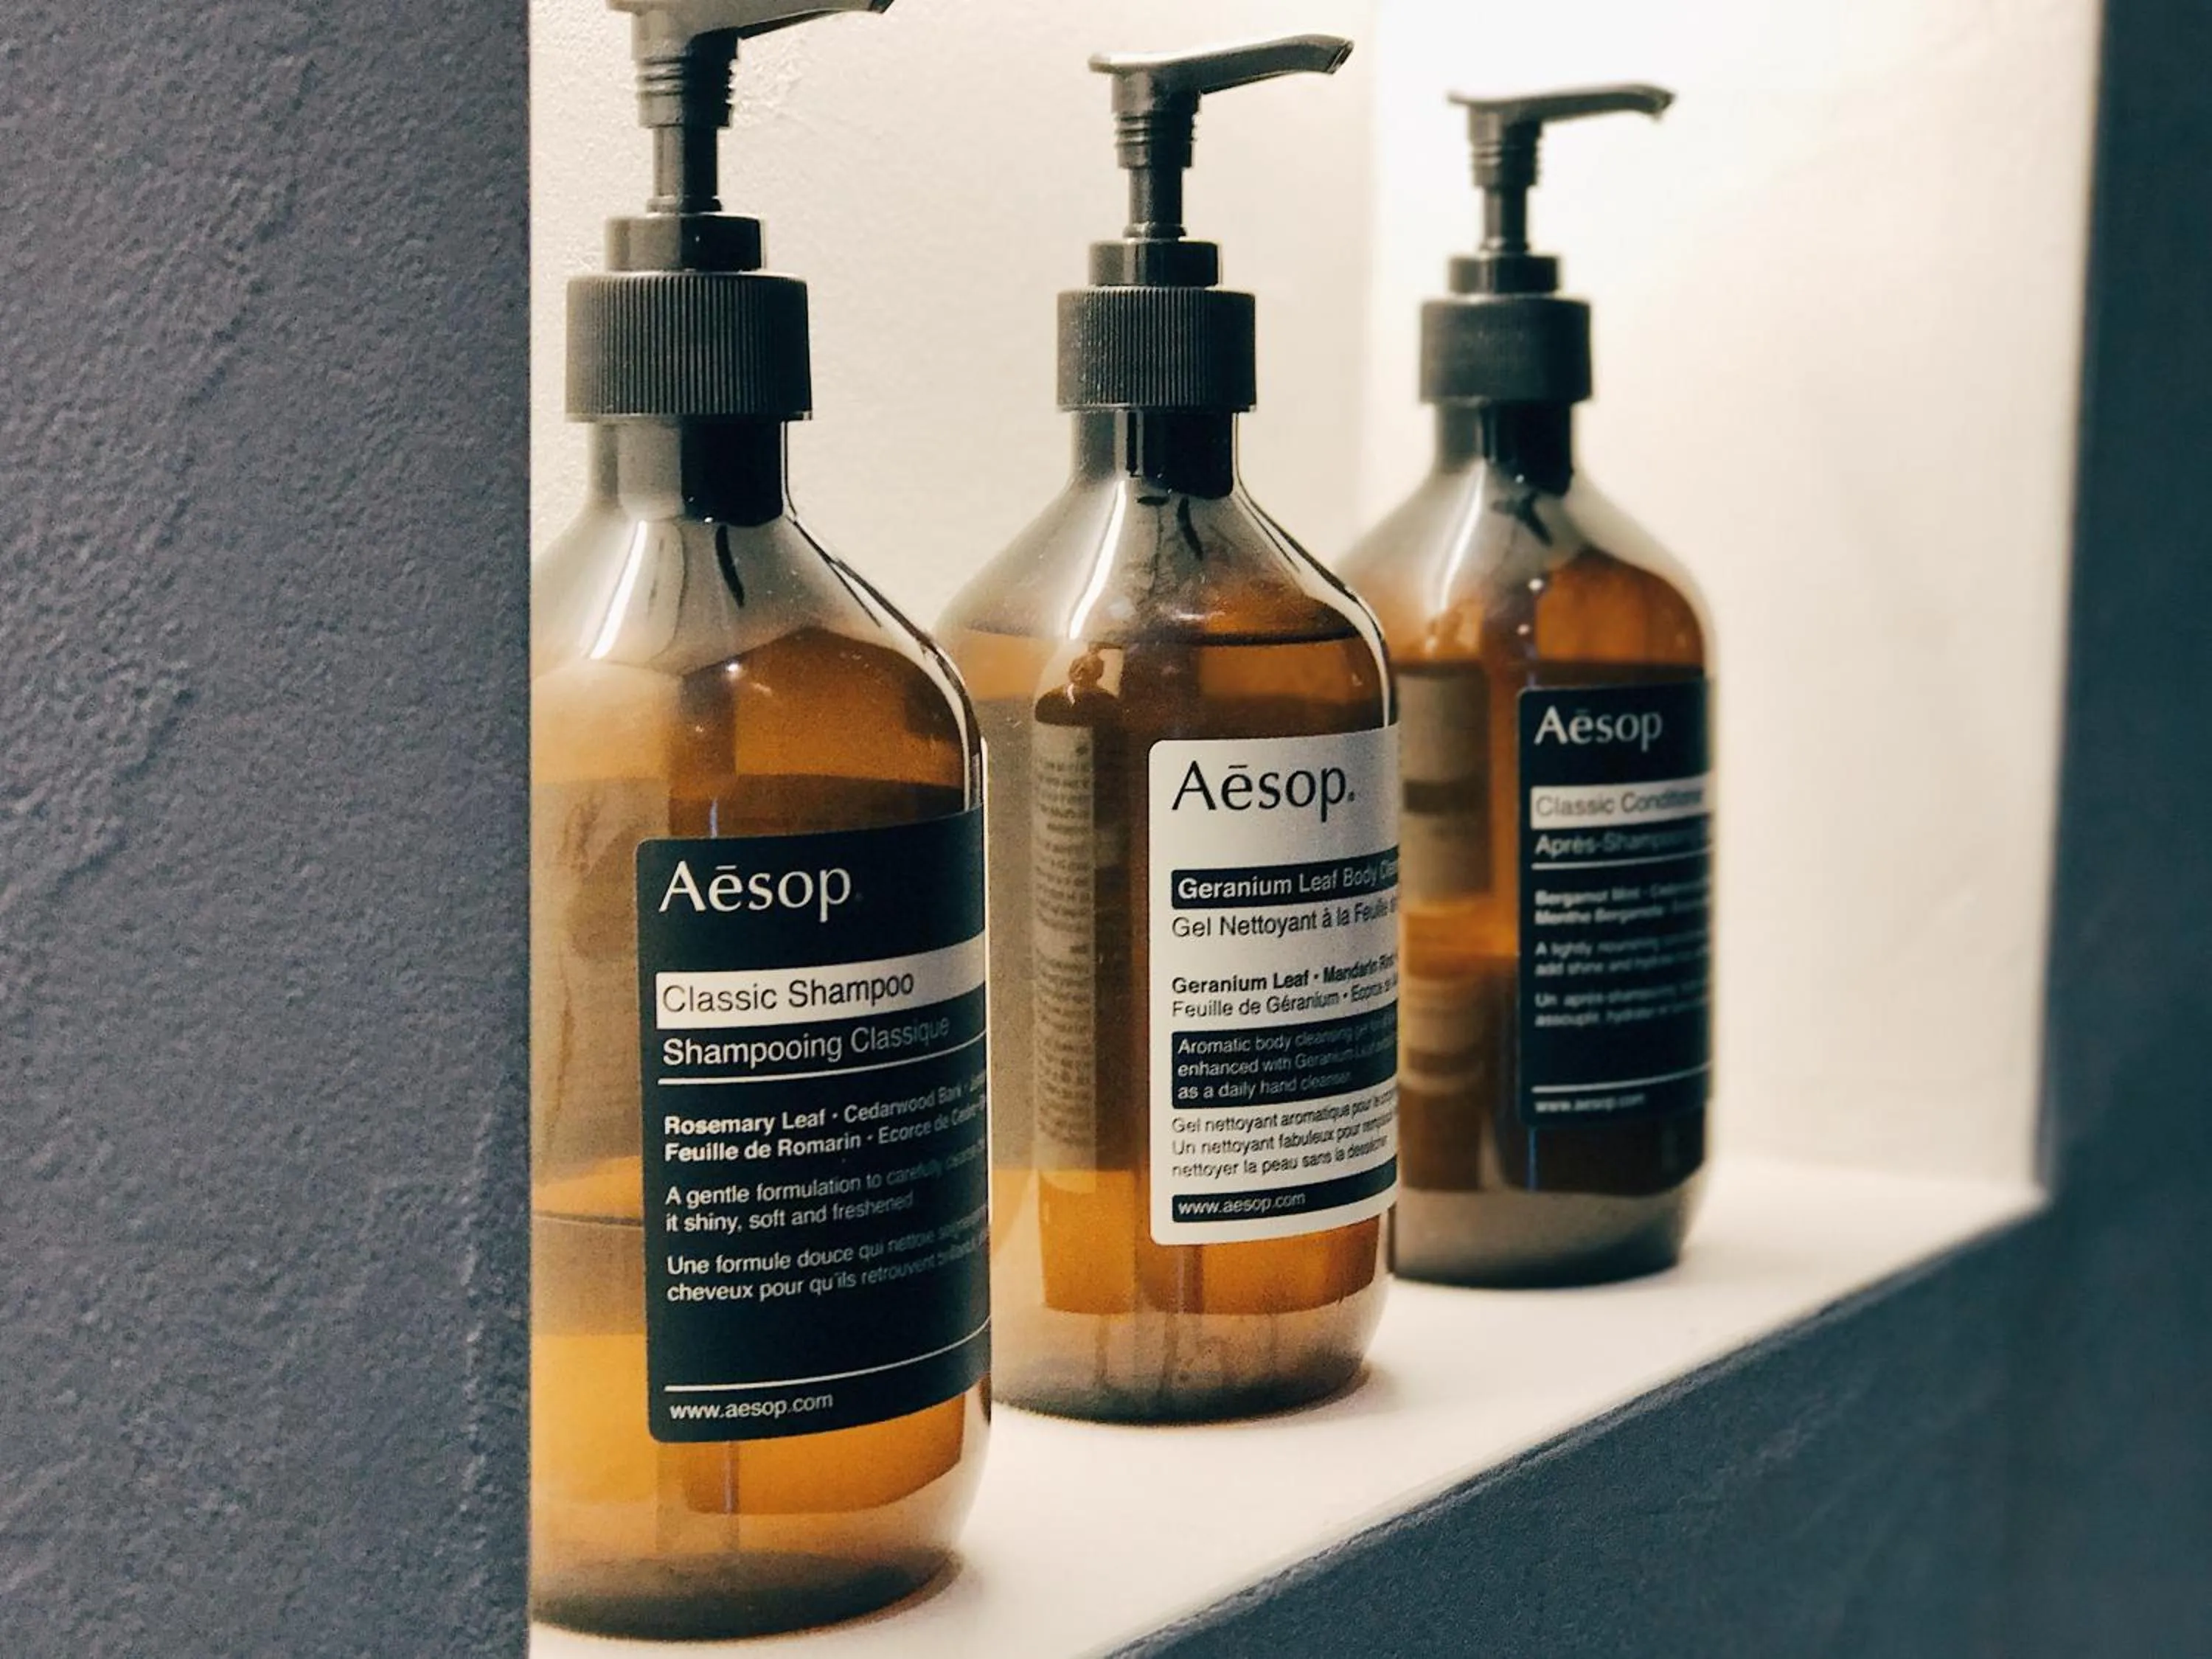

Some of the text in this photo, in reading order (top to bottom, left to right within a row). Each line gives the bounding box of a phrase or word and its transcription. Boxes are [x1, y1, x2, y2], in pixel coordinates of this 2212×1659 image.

[1535, 796, 1615, 817] Classic
[1178, 876, 1292, 899] Geranium
[1299, 870, 1338, 893] Leaf
[1343, 863, 1377, 887] Body
[1172, 917, 1211, 938] Gel
[1220, 911, 1318, 938] Nettoyant
[1337, 906, 1351, 926] la
[664, 973, 914, 1012] Classic Shampoo
[1172, 975, 1267, 993] Geranium
[1273, 970, 1310, 989] Leaf
[1172, 1000, 1233, 1018] Feuille
[1239, 998, 1262, 1015] de
[1266, 992, 1340, 1015] Géranium
[664, 1015, 950, 1068] Shampooing Classique
[1178, 1038, 1251, 1054] Aromatic
[1256, 1034, 1290, 1052] body
[1178, 1060, 1259, 1077] enhanced
[1262, 1057, 1291, 1072] with
[1178, 1086, 1198, 1099] as
[1203, 1087, 1214, 1099] a
[1218, 1080, 1256, 1099] daily
[1259, 1076, 1297, 1095] hand
[664, 1113, 776, 1136] Rosemary
[782, 1109, 826, 1130] Leaf
[844, 1091, 935, 1124] Cedarwood
[1172, 1117, 1200, 1134] Gel
[1205, 1113, 1278, 1133] nettoyant
[664, 1142, 738, 1162] Feuille
[745, 1138, 771, 1158] de
[778, 1132, 861, 1158] Romarin
[879, 1121, 931, 1144] Ecorce
[1172, 1124, 1361, 1159] Un nettoyant fabuleux pour
[1172, 1161, 1239, 1180] nettoyer
[1243, 1158, 1258, 1173] la
[1262, 1156, 1298, 1178] peau
[1301, 1150, 1333, 1168] sans
[665, 1188, 681, 1206] A
[686, 1186, 749, 1209] gentle
[757, 1174, 860, 1202] formulation
[866, 1172, 883, 1189] to
[1178, 1192, 1307, 1215] www.aesop.com
[666, 1191, 914, 1235] it shiny, soft and freshened
[667, 1256, 709, 1275] Une
[716, 1251, 791, 1273] formule
[797, 1244, 855, 1269] douce
[859, 1237, 884, 1263] qui
[667, 1280, 753, 1302] cheveux
[759, 1279, 803, 1302] pour
[861, 1256, 936, 1287] retrouvent
[669, 1393, 834, 1420] www.aesop.com
